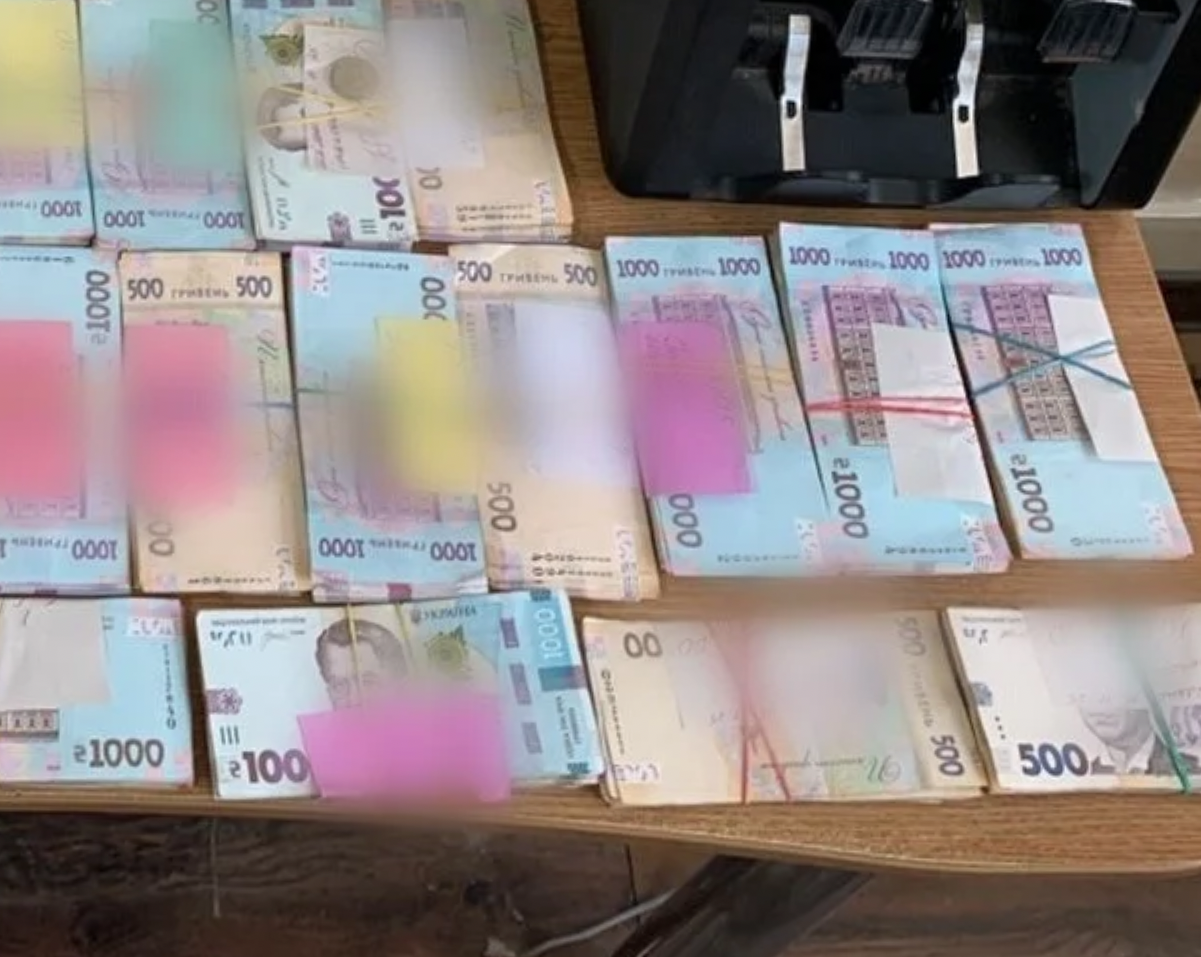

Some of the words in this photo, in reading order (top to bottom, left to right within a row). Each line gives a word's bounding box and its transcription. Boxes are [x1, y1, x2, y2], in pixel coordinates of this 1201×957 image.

[40, 199, 82, 218] 1000
[103, 209, 146, 229] 1000
[202, 210, 245, 229] 1000
[616, 259, 660, 278] 1000
[662, 267, 717, 277] ГРИВЕНЬ
[717, 257, 762, 277] 1000
[788, 246, 831, 267] 1000
[888, 249, 930, 271] 1000
[943, 249, 987, 269] 1000
[1042, 247, 1083, 267] 1000
[456, 260, 493, 283] 500
[499, 272, 559, 283] ГРИВЕНЬ
[562, 262, 598, 286] 500
[127, 278, 164, 299] 500
[170, 288, 229, 299] ГРИВЕНЬ
[235, 276, 273, 298] 500
[487, 482, 517, 533] 500
[667, 494, 703, 548] 000
[148, 518, 175, 556] 00
[318, 537, 365, 559] 1000
[71, 540, 118, 561] 1000
[430, 542, 478, 562] 1000
[535, 607, 561, 661] 1000
[623, 631, 663, 660] 00
[228, 749, 311, 784] ₴100
[930, 735, 965, 778] 500
[1017, 742, 1090, 778] 500
